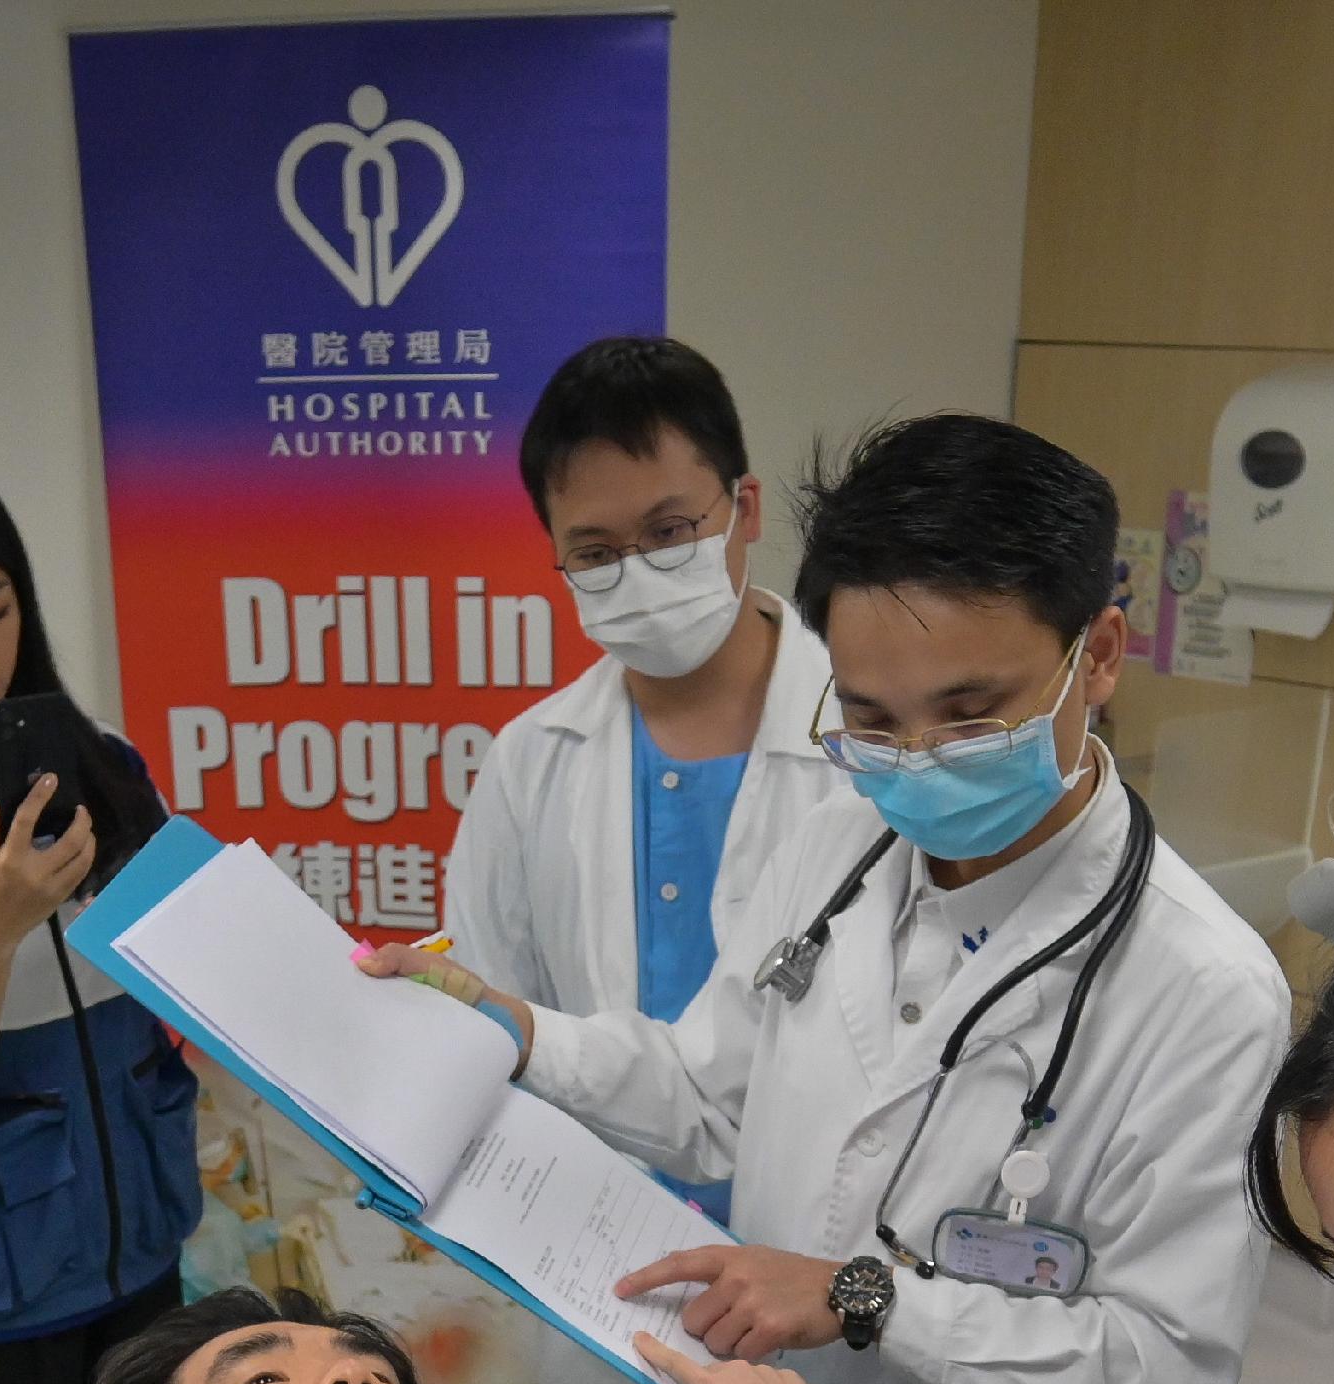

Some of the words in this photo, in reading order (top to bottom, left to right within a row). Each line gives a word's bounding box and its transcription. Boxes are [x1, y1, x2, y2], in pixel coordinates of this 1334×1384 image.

[261, 328, 492, 369] 醫院管理局
[267, 391, 493, 423] HOSPITAL
[268, 430, 494, 457] AUTHORITY
[222, 576, 434, 688] Drill
[455, 576, 555, 689] in
[168, 705, 496, 824] Progre
[270, 841, 450, 931] 練進
